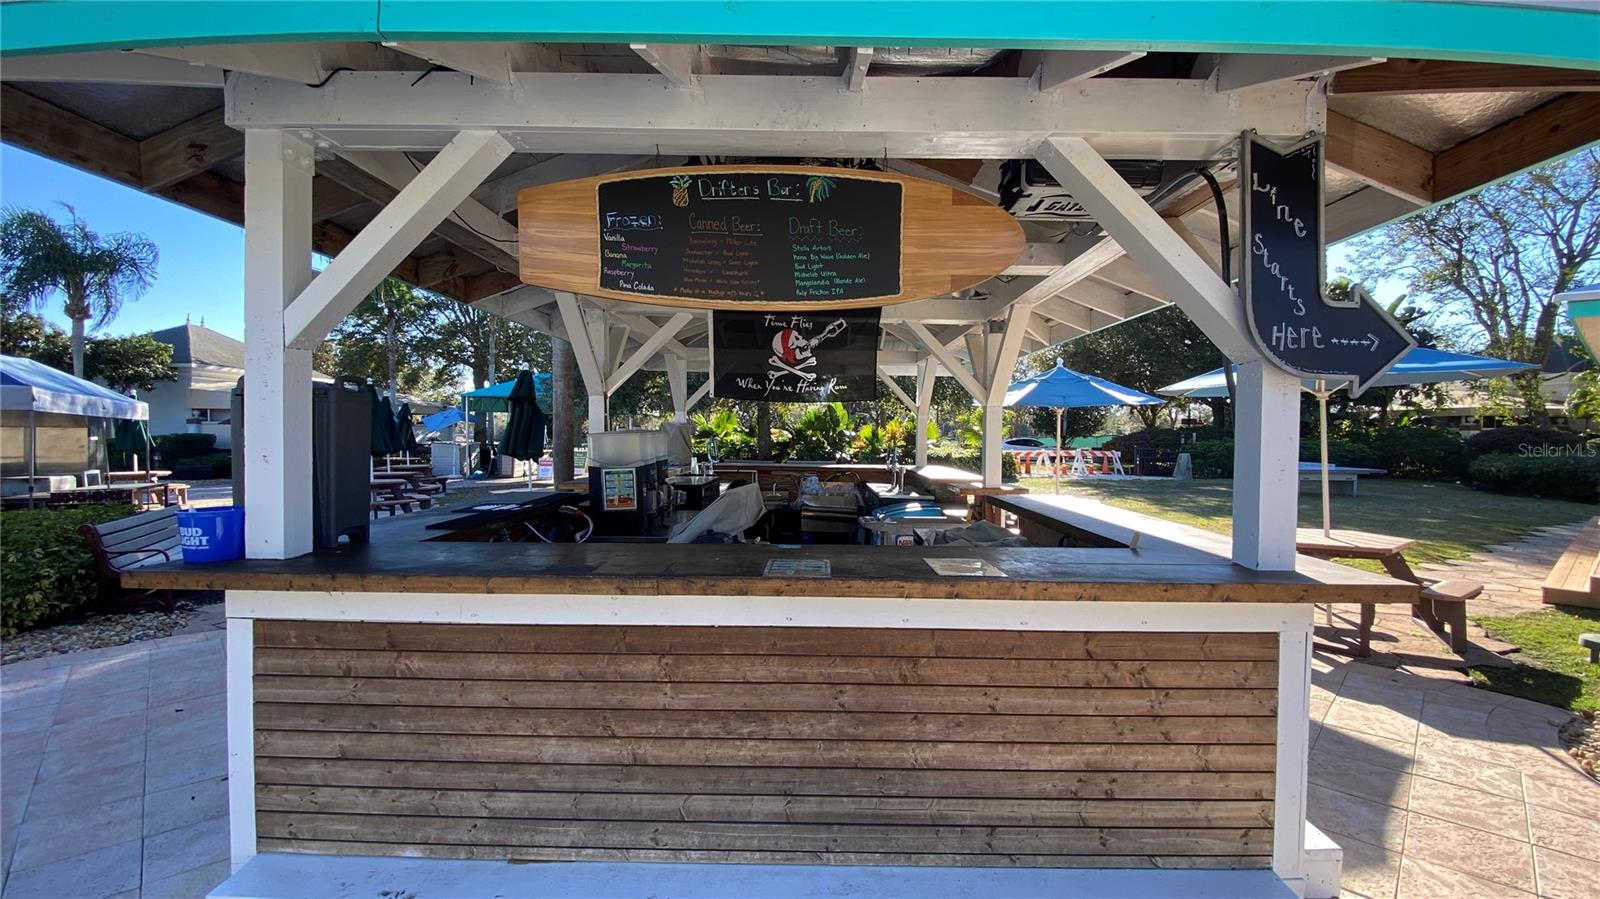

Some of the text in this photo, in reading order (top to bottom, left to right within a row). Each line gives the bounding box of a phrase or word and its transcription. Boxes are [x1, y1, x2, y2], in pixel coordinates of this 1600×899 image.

[1253, 172, 1306, 238] Line
[689, 212, 728, 231] Canned
[789, 216, 823, 234] Draft
[603, 232, 626, 242] Vanilla
[605, 249, 628, 259] Banana
[621, 242, 658, 255] Strawberry
[1253, 233, 1306, 316] Starts
[764, 313, 813, 330] Time Flies
[1272, 322, 1325, 351] Here
[736, 376, 763, 390] When
[827, 376, 848, 395] Rum
